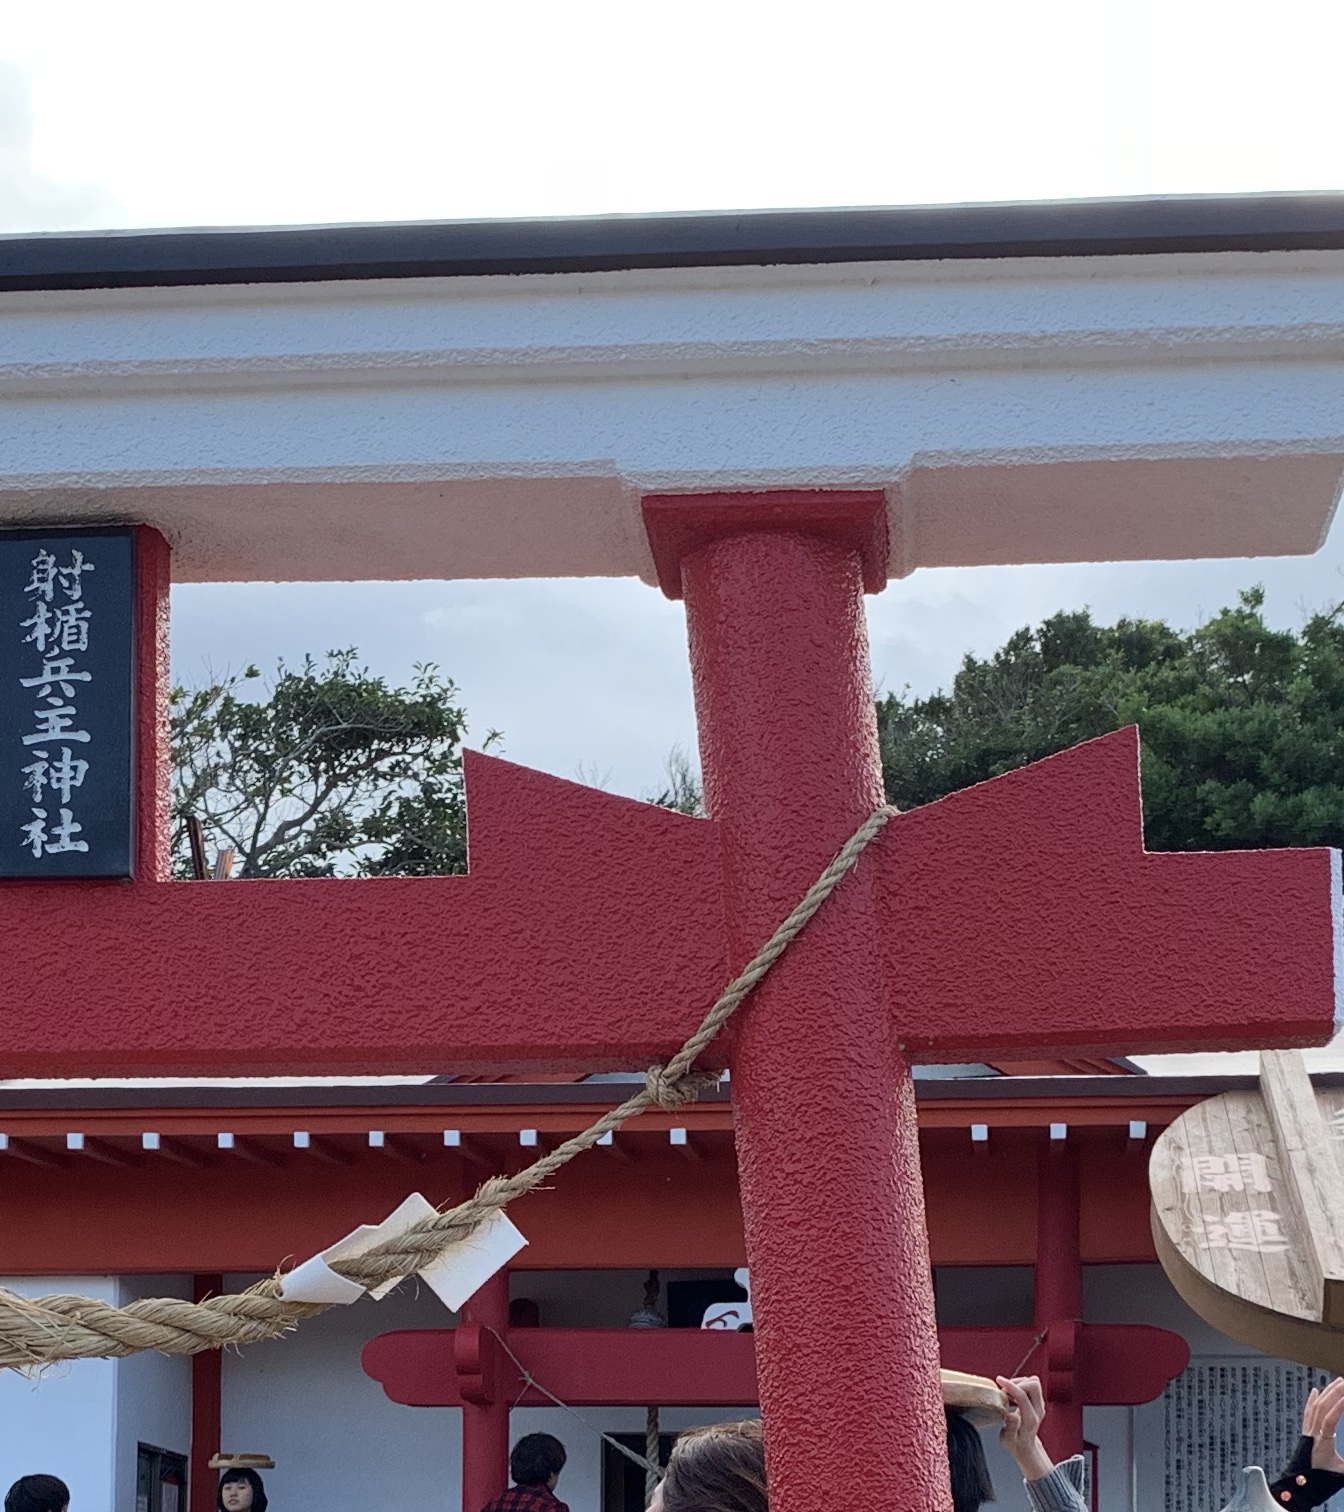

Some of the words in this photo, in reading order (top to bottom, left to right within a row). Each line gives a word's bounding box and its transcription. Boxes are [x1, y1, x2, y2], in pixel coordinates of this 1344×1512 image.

[19, 548, 95, 858] 射楯兵主神社
[1180, 1153, 1291, 1253] 開運
